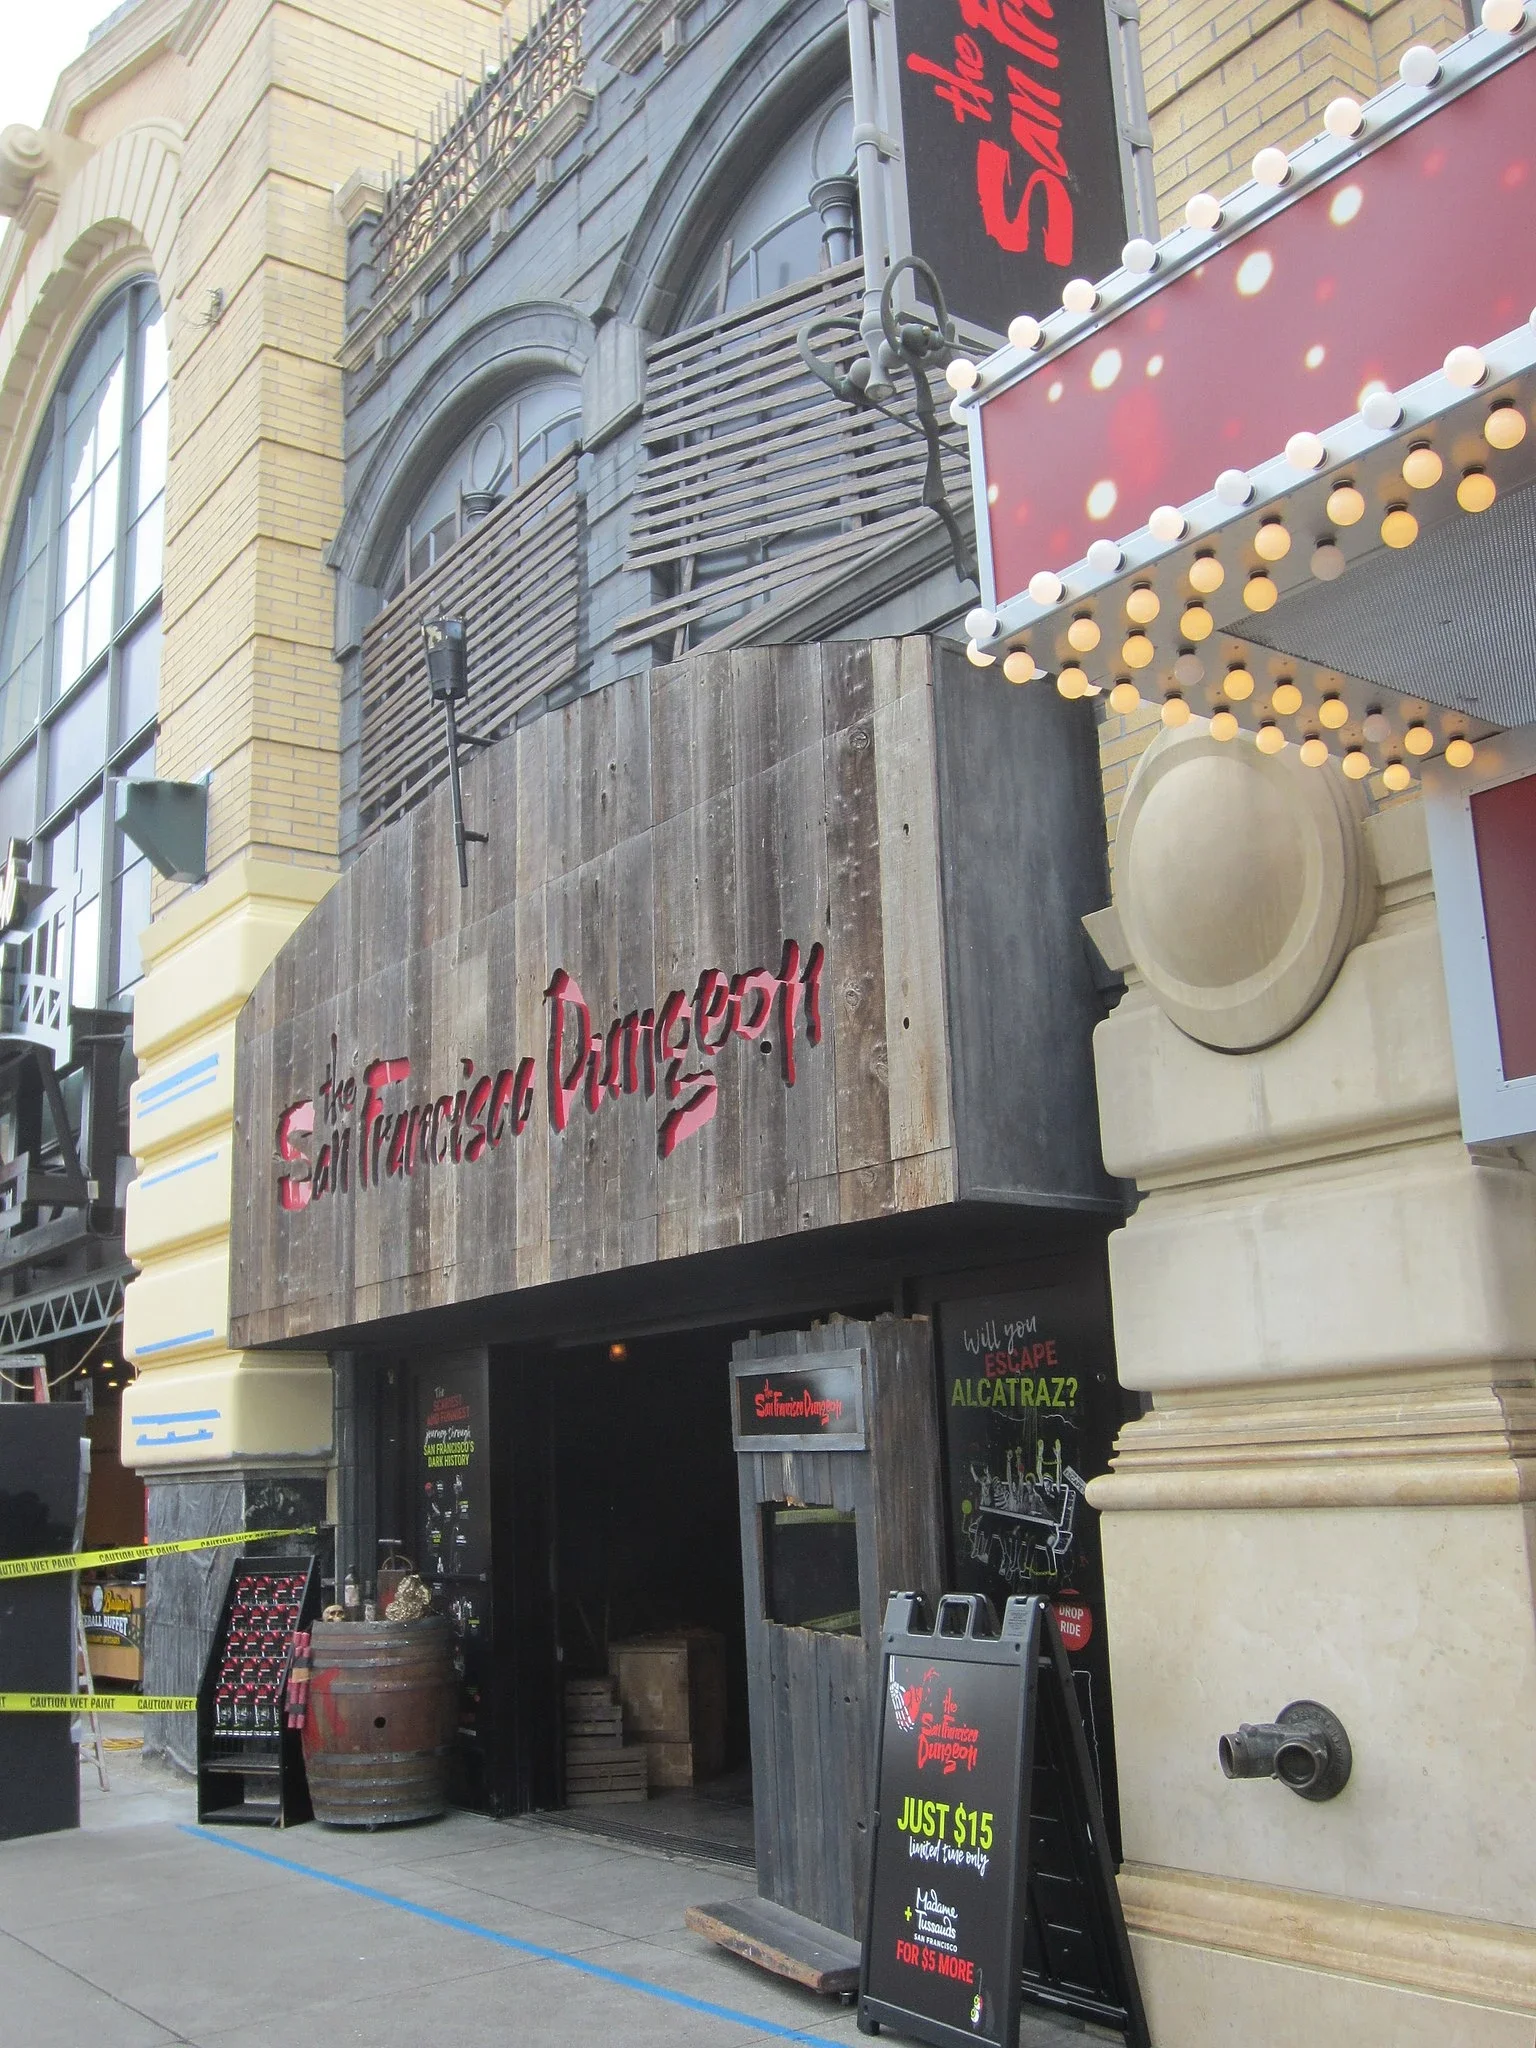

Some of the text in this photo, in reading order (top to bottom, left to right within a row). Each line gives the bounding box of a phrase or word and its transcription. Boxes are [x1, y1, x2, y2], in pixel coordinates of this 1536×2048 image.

[906, 33, 994, 123] the
[977, 65, 1073, 267] San
[276, 939, 824, 1212] San Francisco Dungeon
[319, 1032, 357, 1126] the
[963, 1315, 1037, 1355] Will you
[984, 1339, 1058, 1378] ESCAPE
[764, 1378, 773, 1398] the
[951, 1377, 1078, 1407] ALCATRAZ?
[755, 1389, 842, 1425] San Francisco Dungeon
[423, 1441, 475, 1456] SAN FRANCISCO'S
[425, 1425, 472, 1446] journey through
[428, 1454, 470, 1468] DARK HISTORY
[0, 1556, 77, 1576] UTION WET PAINT
[99, 1544, 179, 1563] CAUTION WET PAINT
[103, 1615, 129, 1637] BUFFET
[1059, 1605, 1084, 1621] DROP
[1060, 1620, 1081, 1637] RIDE
[30, 1696, 115, 1709] CAUTION WET PAINT
[138, 1699, 193, 1710] CAUTION WET
[943, 1688, 958, 1714] the
[921, 1712, 979, 1743] San Francisco
[917, 1733, 978, 1775] Dungeon
[897, 1796, 994, 1850] JUST $15
[909, 1835, 990, 1877] limited time only
[916, 1887, 959, 1919] Madame
[915, 1908, 957, 1939] Tussauds
[913, 1933, 958, 1953] SAN FRANCISCO
[896, 1939, 975, 1984] FOR $5 MORE
